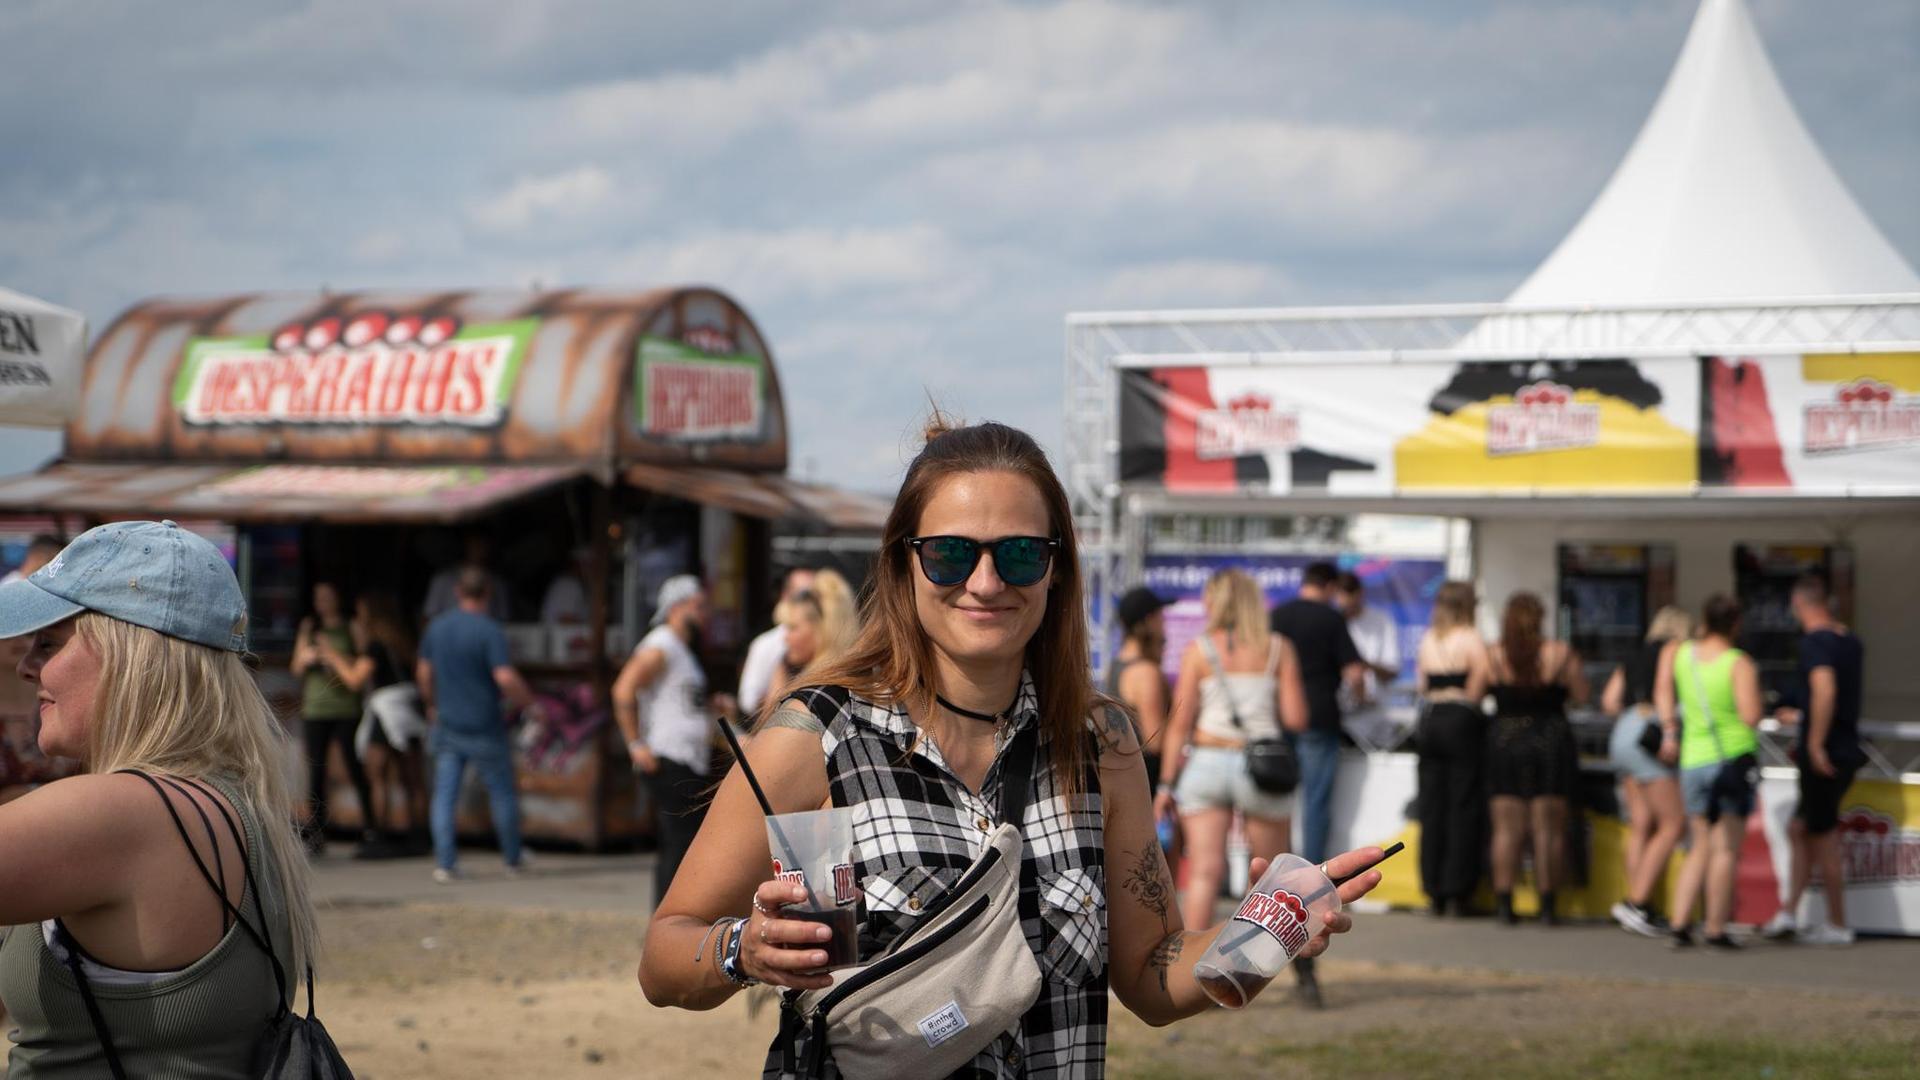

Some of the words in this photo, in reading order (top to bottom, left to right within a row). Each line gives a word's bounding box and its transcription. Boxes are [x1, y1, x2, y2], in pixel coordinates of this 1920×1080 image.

[198, 345, 496, 416] DESPERADOS
[928, 1012, 954, 1029] #inthe
[933, 1017, 958, 1037] crowd
